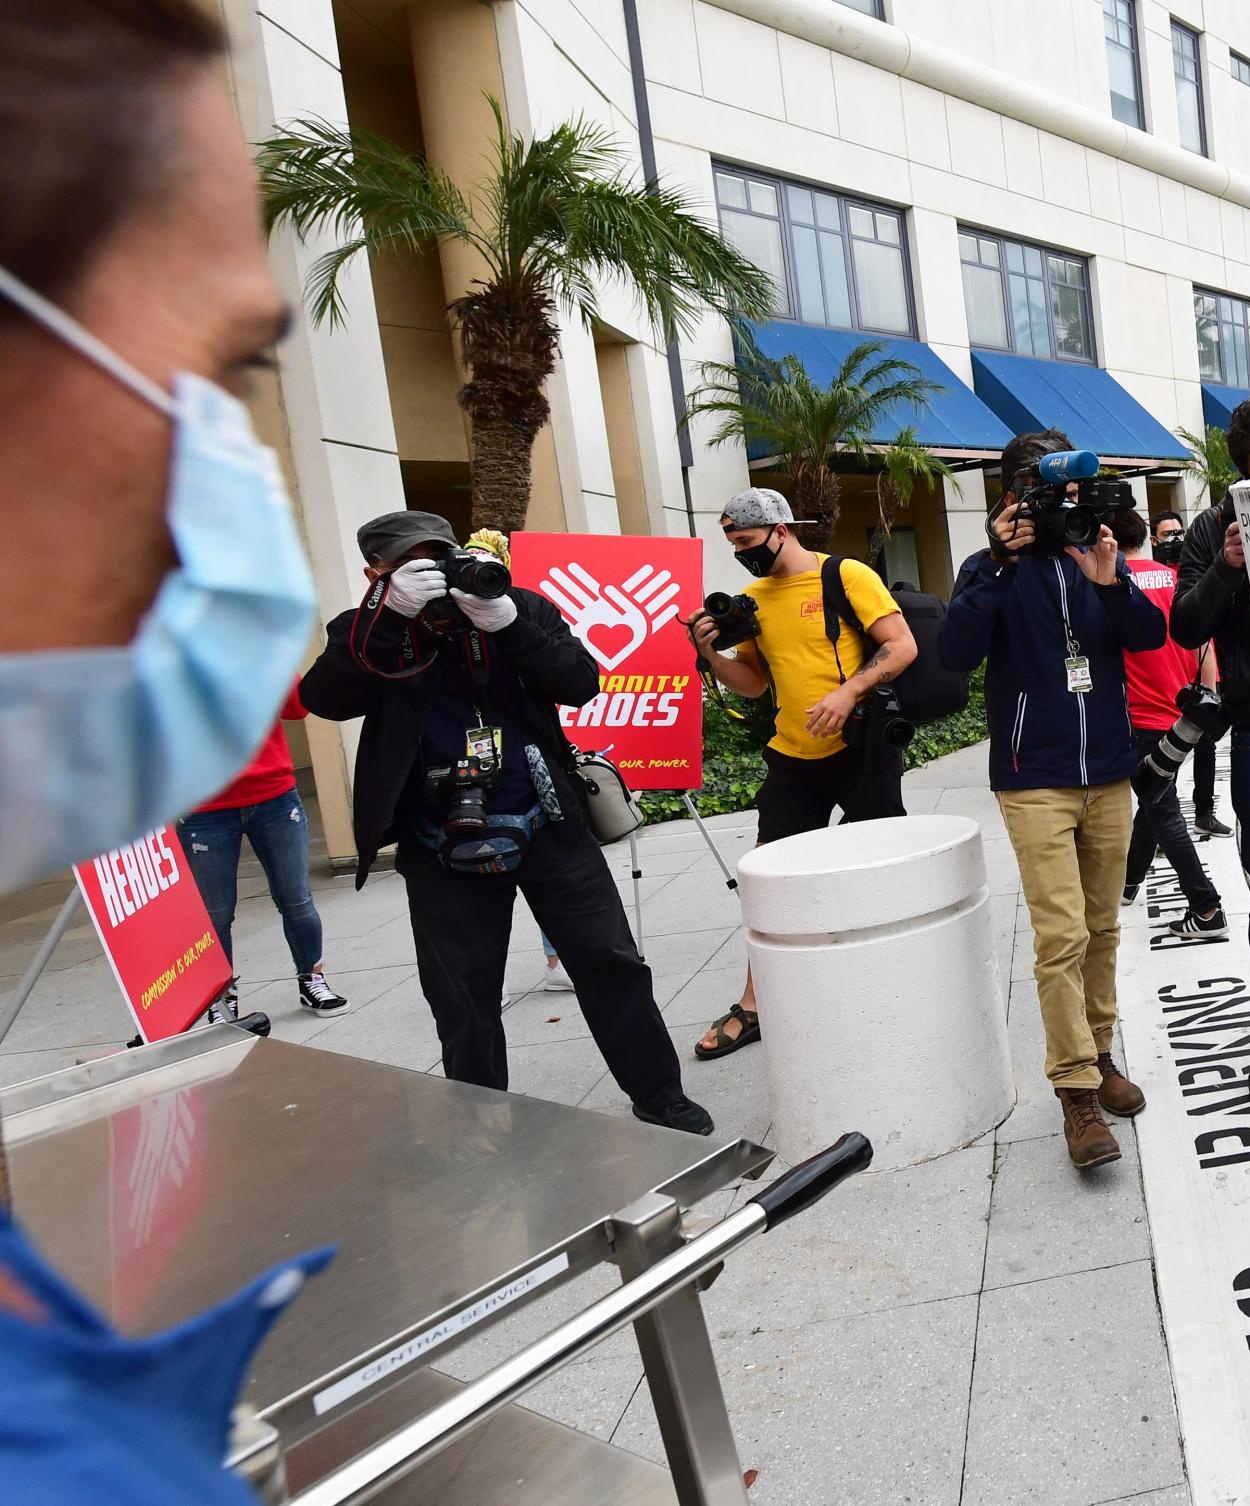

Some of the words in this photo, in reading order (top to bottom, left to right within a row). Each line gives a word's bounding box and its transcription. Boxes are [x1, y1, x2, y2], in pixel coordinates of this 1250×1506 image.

[367, 580, 385, 610] Canon
[1137, 576, 1175, 590] HEROES
[470, 630, 482, 661] Canon
[558, 692, 684, 727] EROES
[619, 759, 646, 769] OUR
[648, 759, 690, 769] POWER
[93, 824, 180, 929] HEROES
[141, 965, 177, 1011] COMPASSION
[176, 958, 184, 974] IS
[183, 946, 198, 968] OUR
[195, 931, 215, 959] POWER
[362, 1326, 454, 1382] CENTRAL
[460, 1275, 537, 1324] SERVICE
